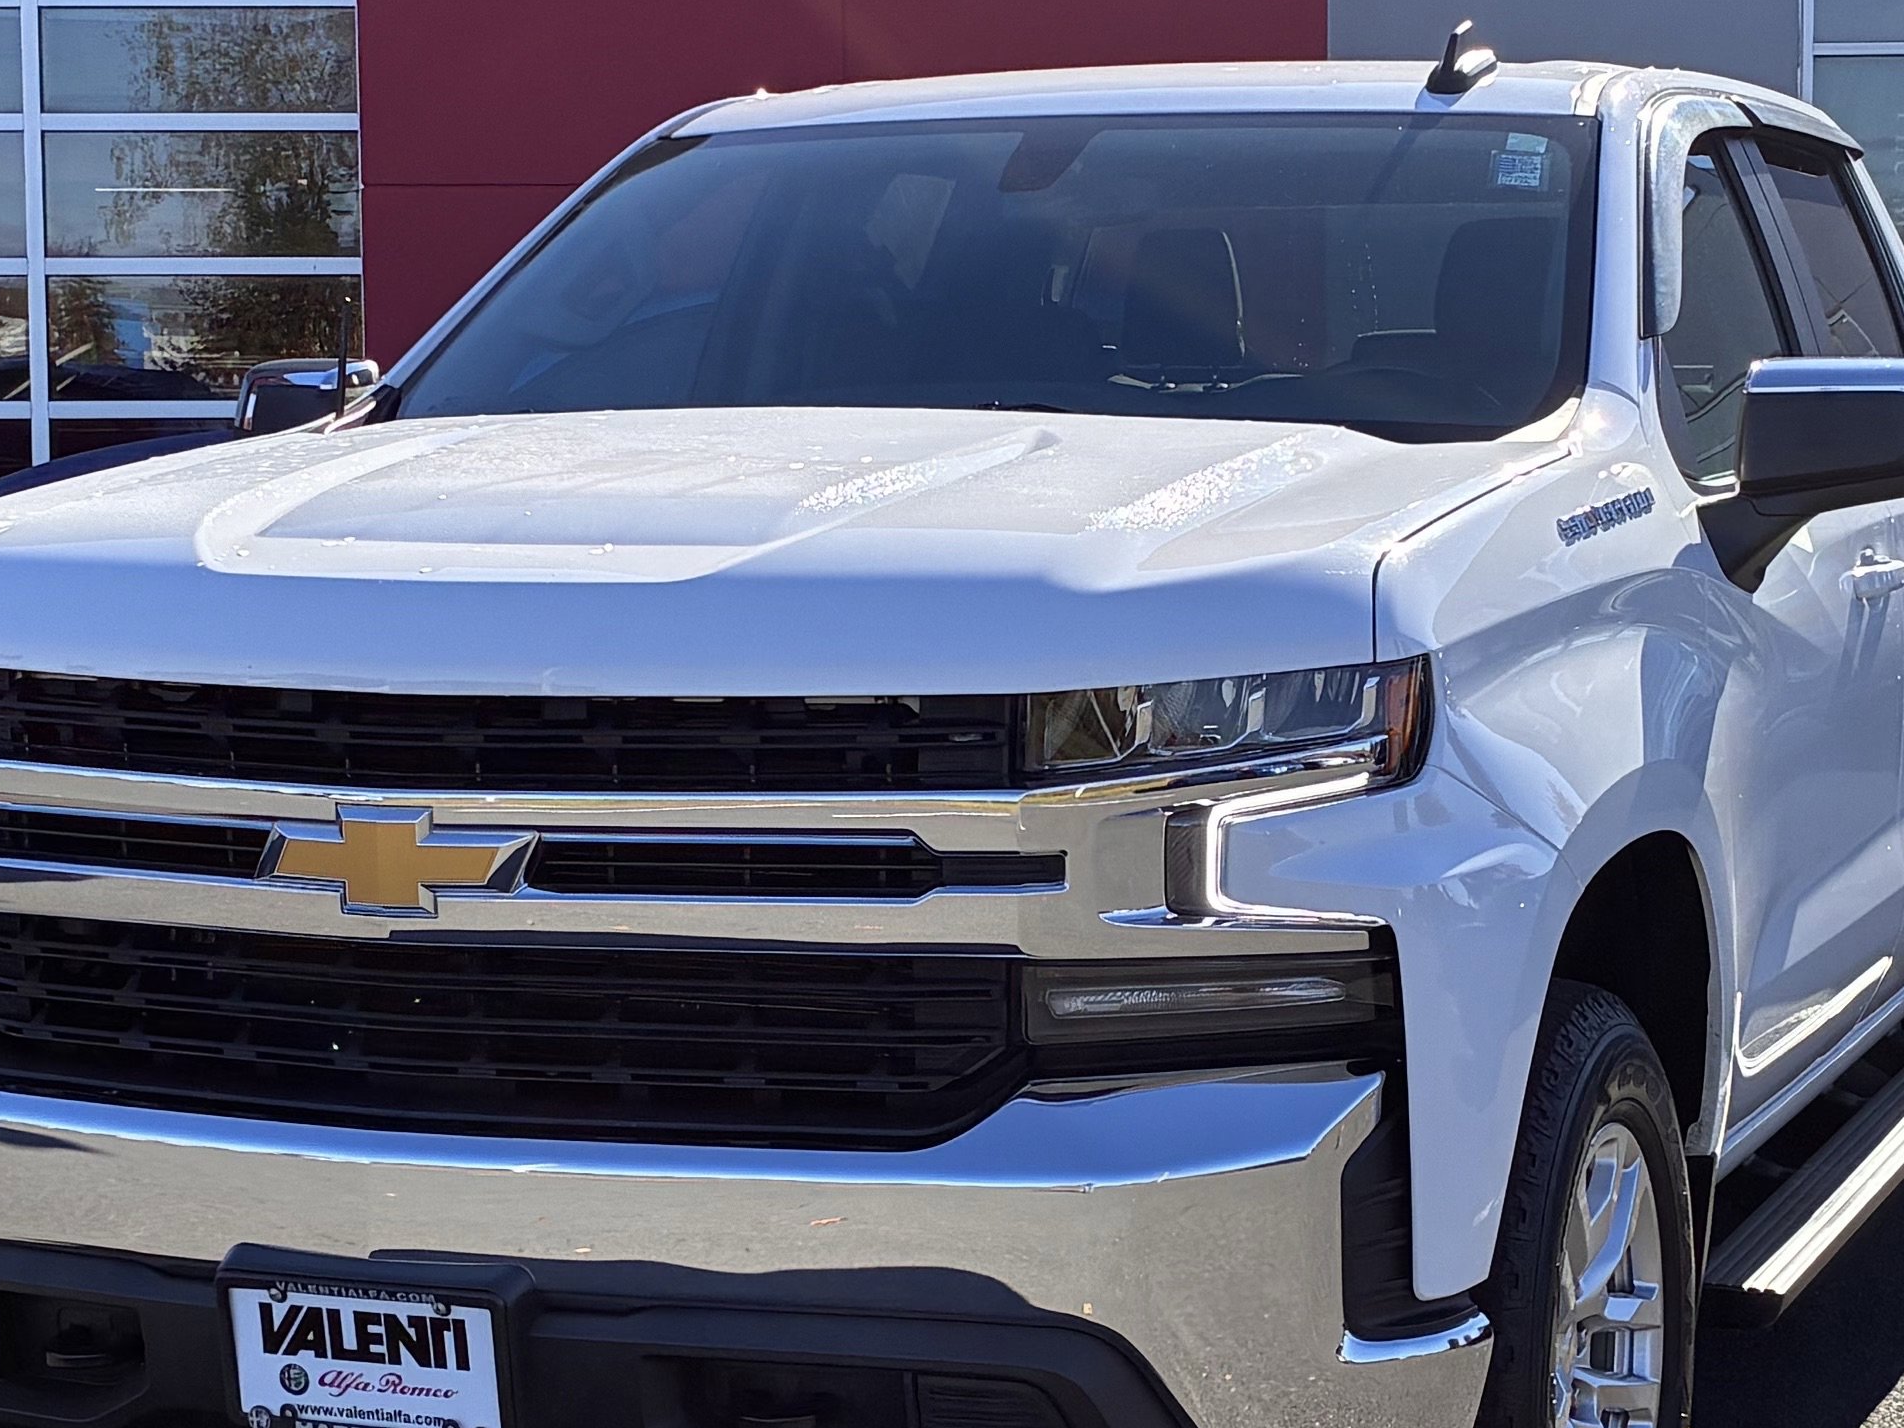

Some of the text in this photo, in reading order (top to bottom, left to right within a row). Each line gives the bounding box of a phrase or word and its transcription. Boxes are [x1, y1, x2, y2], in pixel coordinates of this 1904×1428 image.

[276, 1280, 437, 1305] VALENTIALFA.COM
[258, 1302, 471, 1371] VALENTI
[317, 1369, 459, 1399] Alfa Romeo
[296, 1403, 445, 1428] www.valentialfa.com
